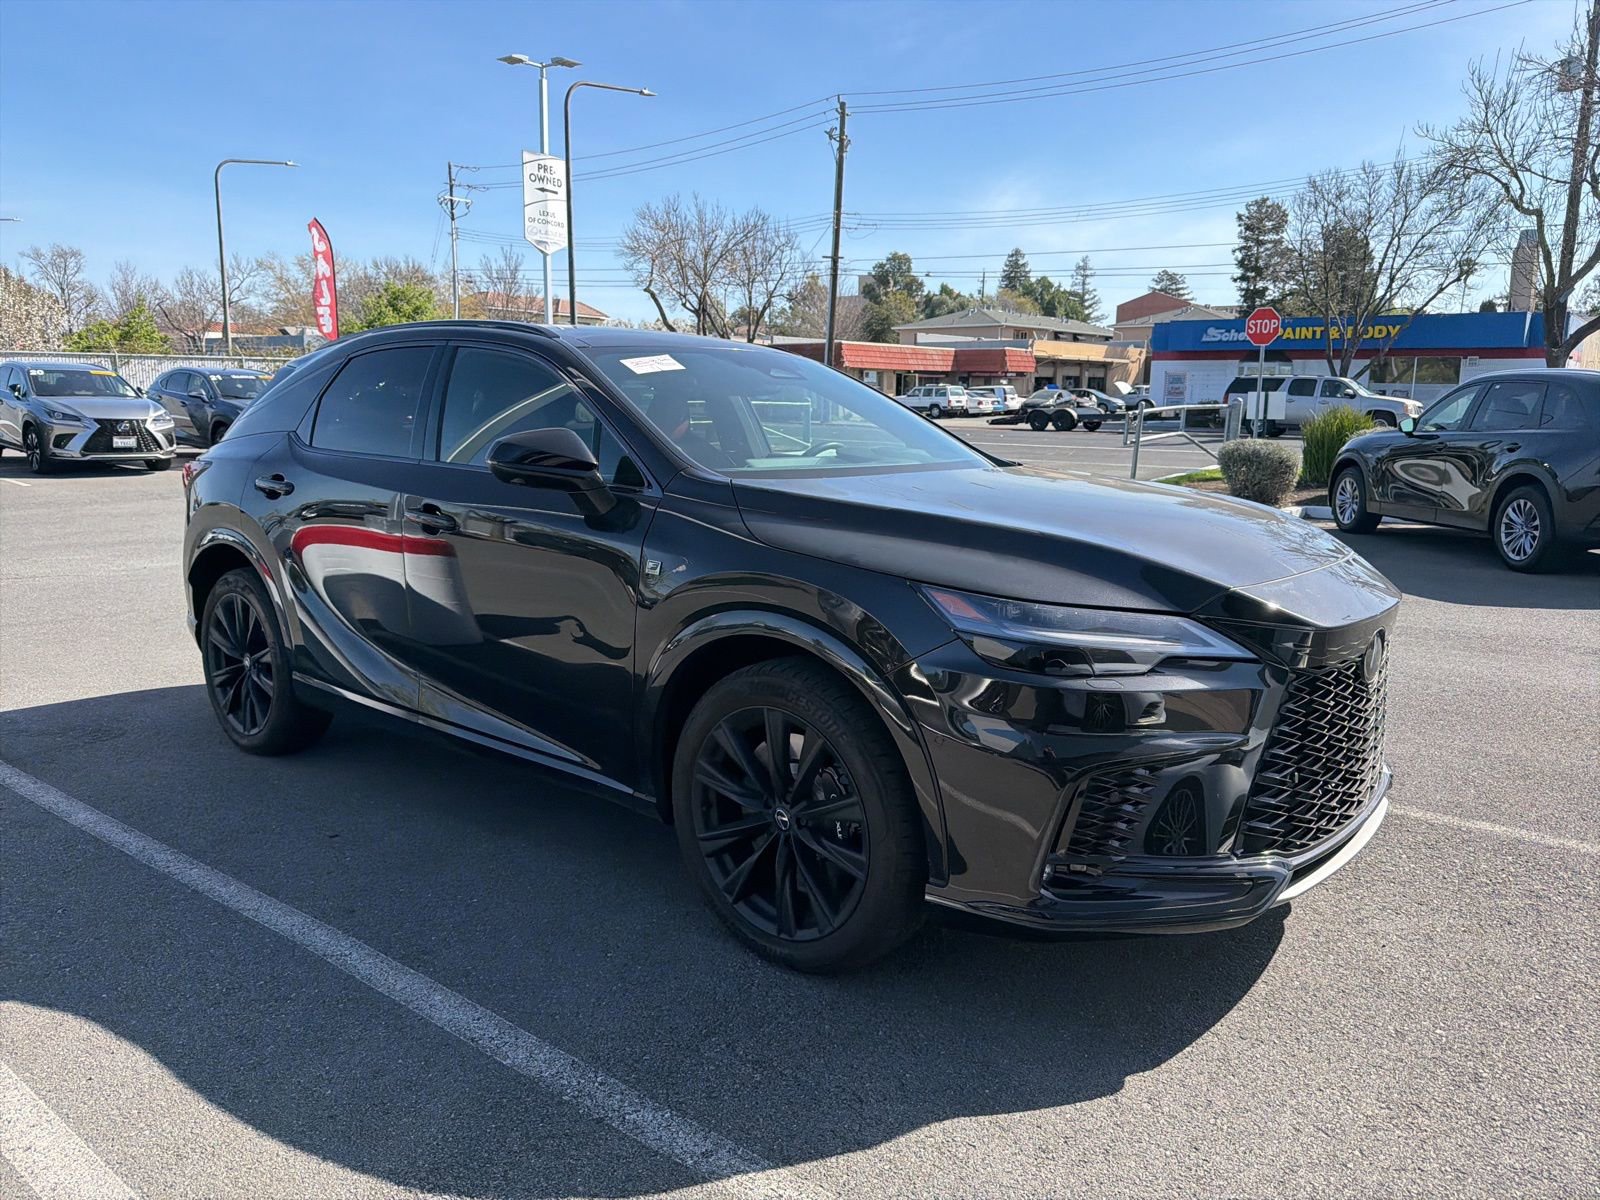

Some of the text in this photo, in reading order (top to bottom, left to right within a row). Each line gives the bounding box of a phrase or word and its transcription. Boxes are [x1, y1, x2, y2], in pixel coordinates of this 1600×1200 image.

[537, 163, 556, 175] PRE-
[528, 173, 562, 188] OWNED
[537, 217, 564, 228] CONCORD
[1248, 319, 1279, 334] STOP
